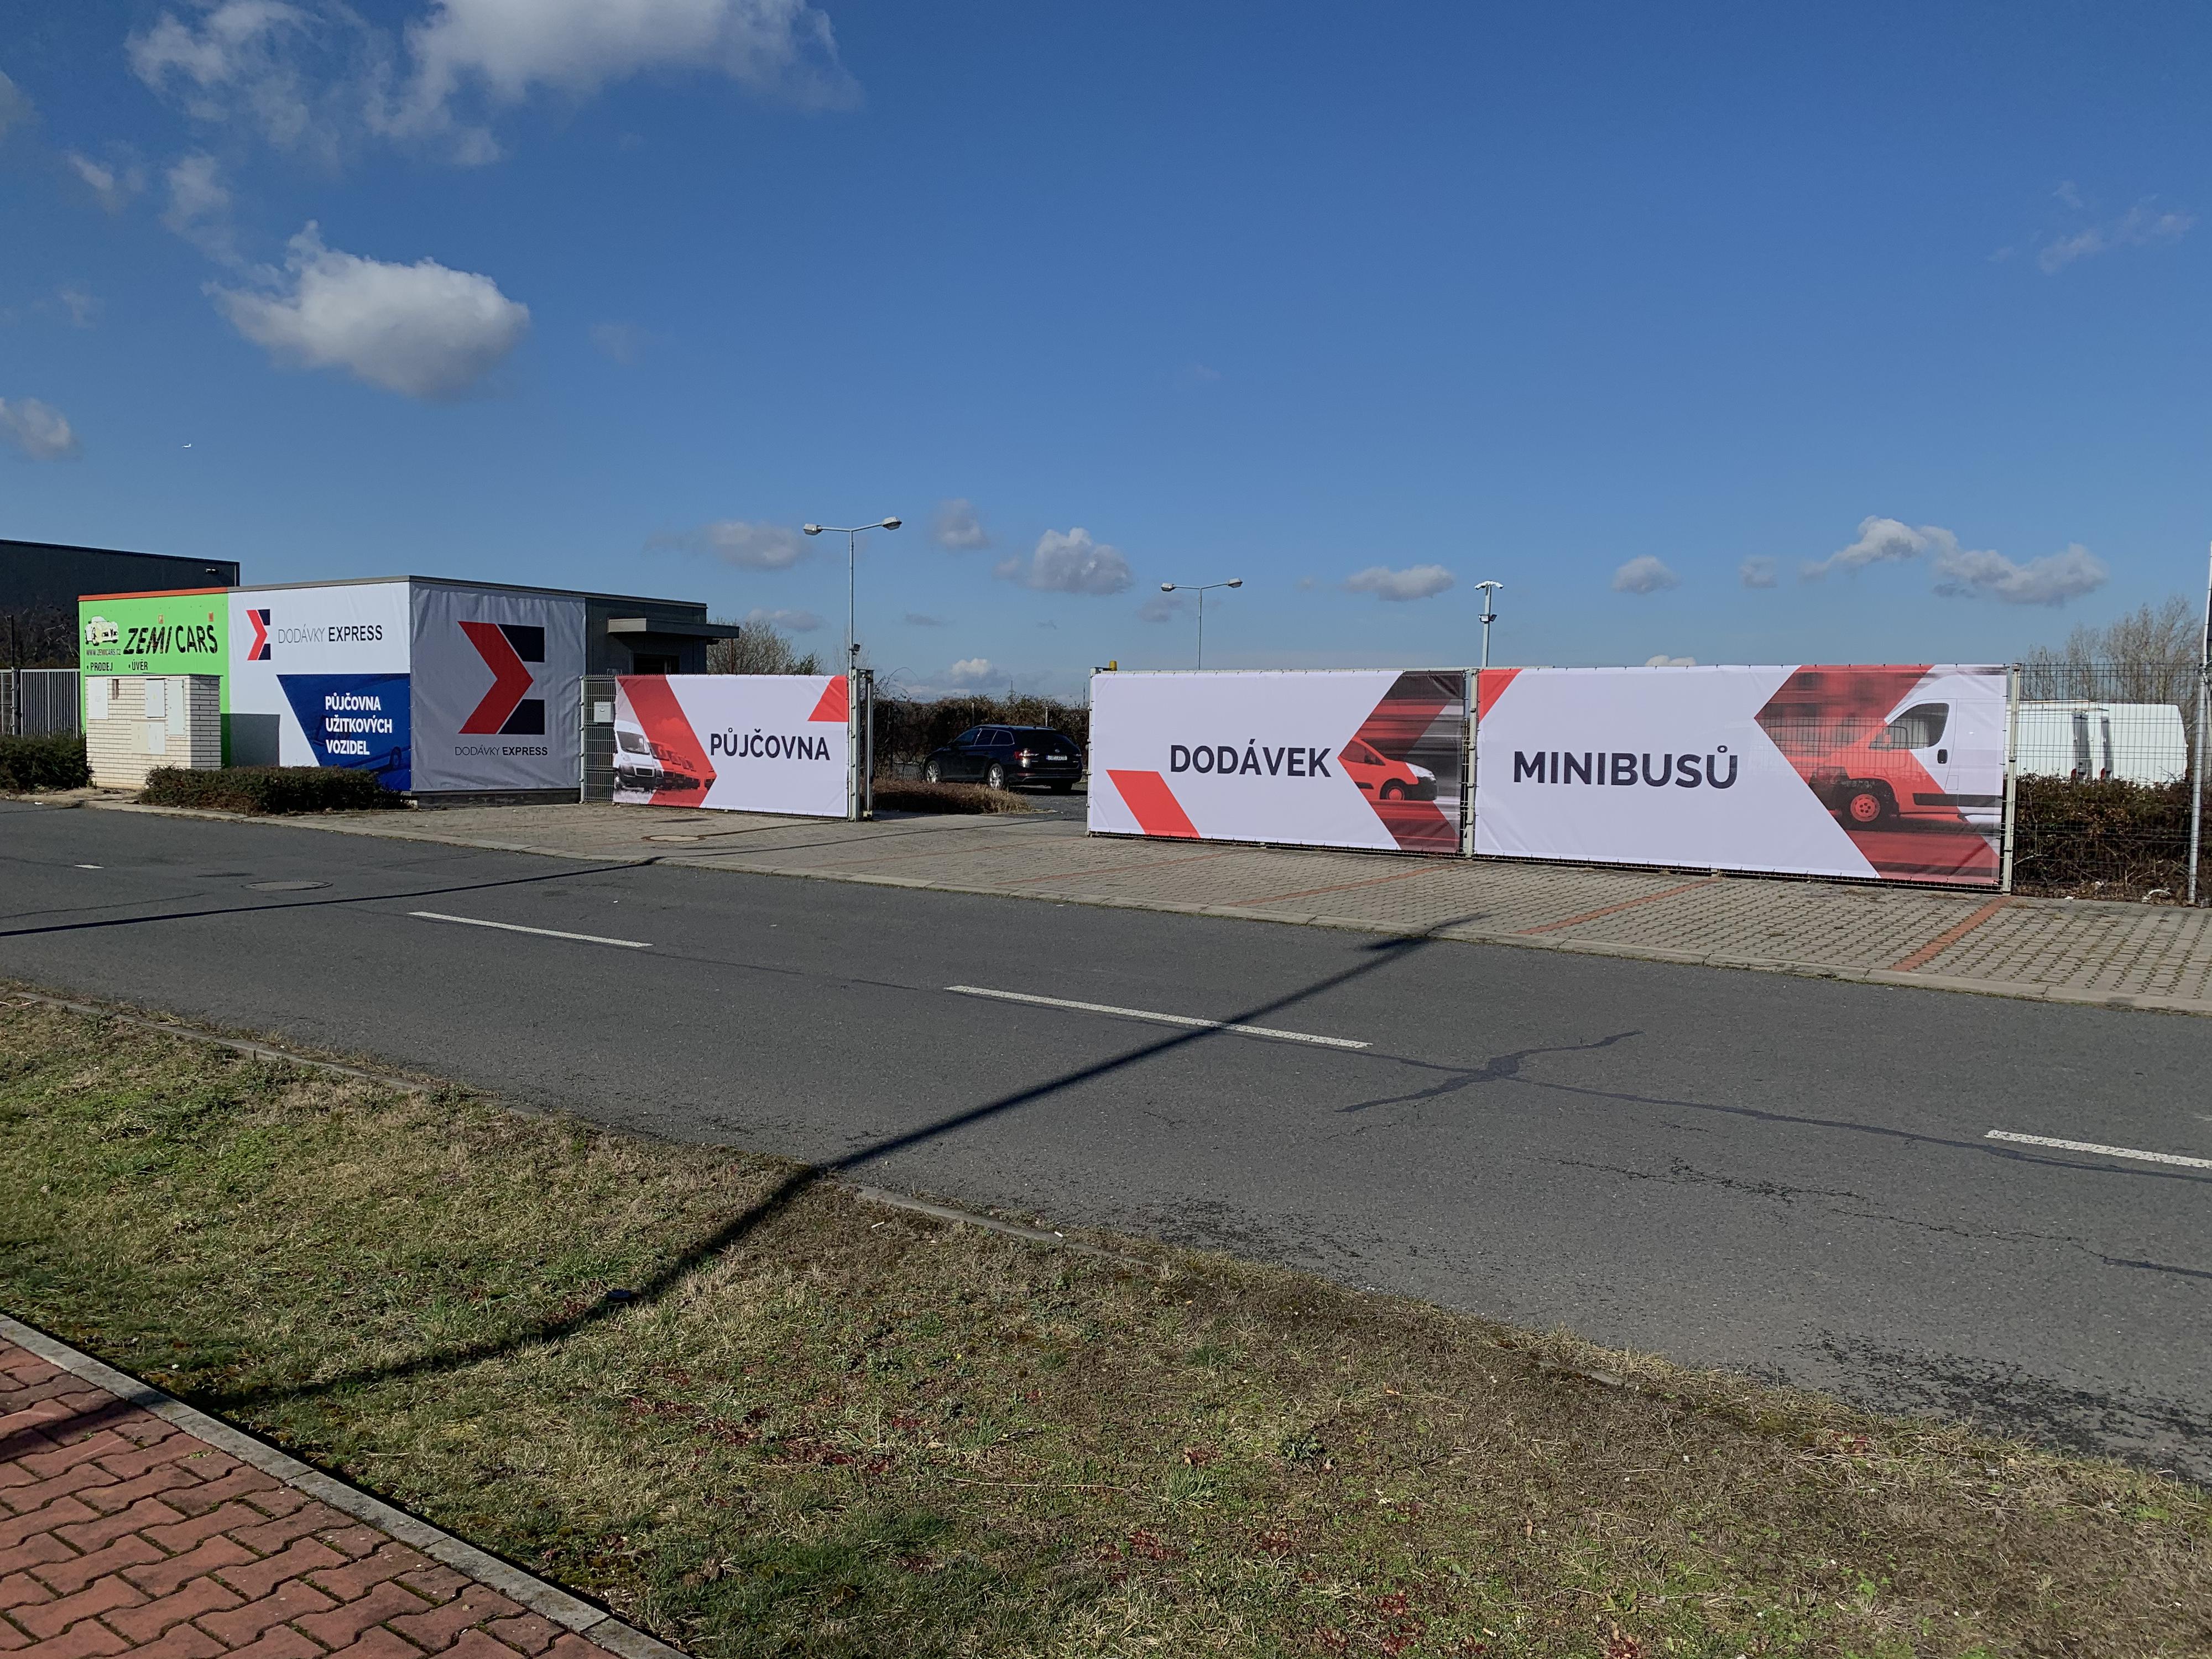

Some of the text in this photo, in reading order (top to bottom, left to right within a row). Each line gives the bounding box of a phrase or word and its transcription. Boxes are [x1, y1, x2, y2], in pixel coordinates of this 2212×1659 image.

[123, 625, 218, 654] ZEMI CARS
[278, 624, 383, 643] DODÁVKY EXPRESS
[90, 662, 113, 671] PRODEJ
[132, 659, 148, 671] ÚVĚR
[325, 692, 382, 711] PŮJČOVNA
[325, 714, 393, 733] UŽITKOVÝCH
[325, 739, 370, 755] VOZIDEL
[455, 744, 548, 755] DODÁVKY EXPRESS
[710, 727, 831, 760] PŮJČOVNA
[1170, 738, 1332, 778] DODÁVEK
[1514, 745, 1738, 789] MINIBUSŮ
